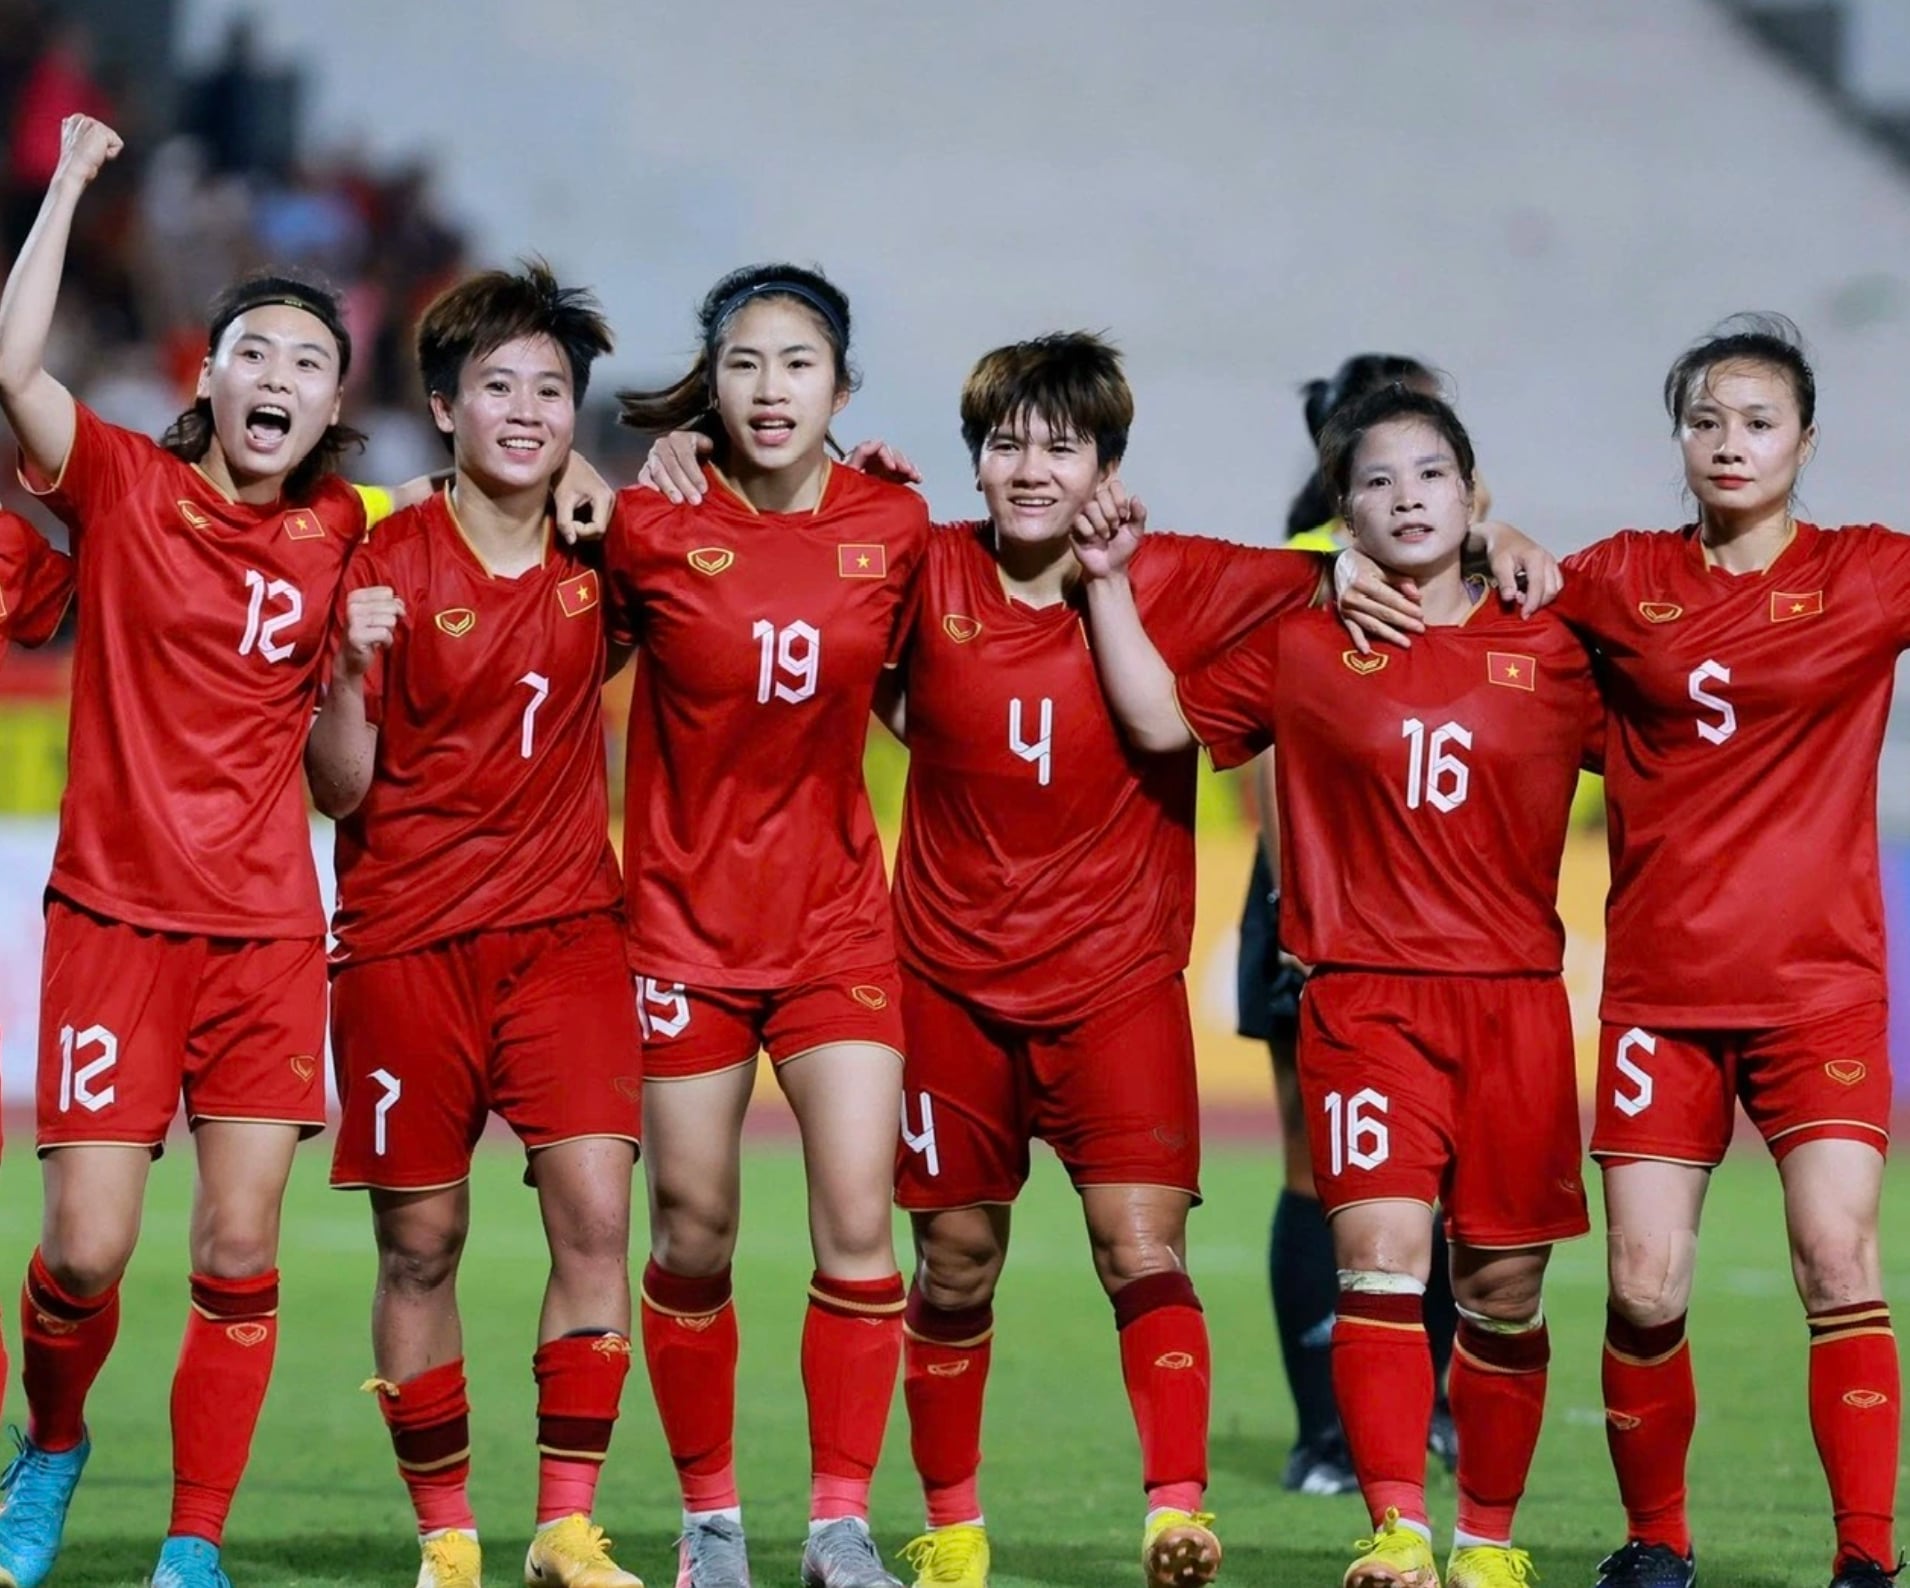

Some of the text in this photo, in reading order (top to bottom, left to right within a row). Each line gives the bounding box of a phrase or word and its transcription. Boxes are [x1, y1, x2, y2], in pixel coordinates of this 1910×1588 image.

[238, 569, 303, 663] 12
[752, 618, 820, 704] 19
[1688, 659, 1737, 745] 5
[514, 671, 549, 759] 7
[1009, 697, 1053, 786] 4
[1401, 717, 1473, 813] 16
[59, 1024, 118, 1113] 12
[367, 1067, 402, 1156] 7
[1613, 1027, 1656, 1117] 5
[900, 1090, 940, 1176] 4
[1324, 1087, 1389, 1176] 16
